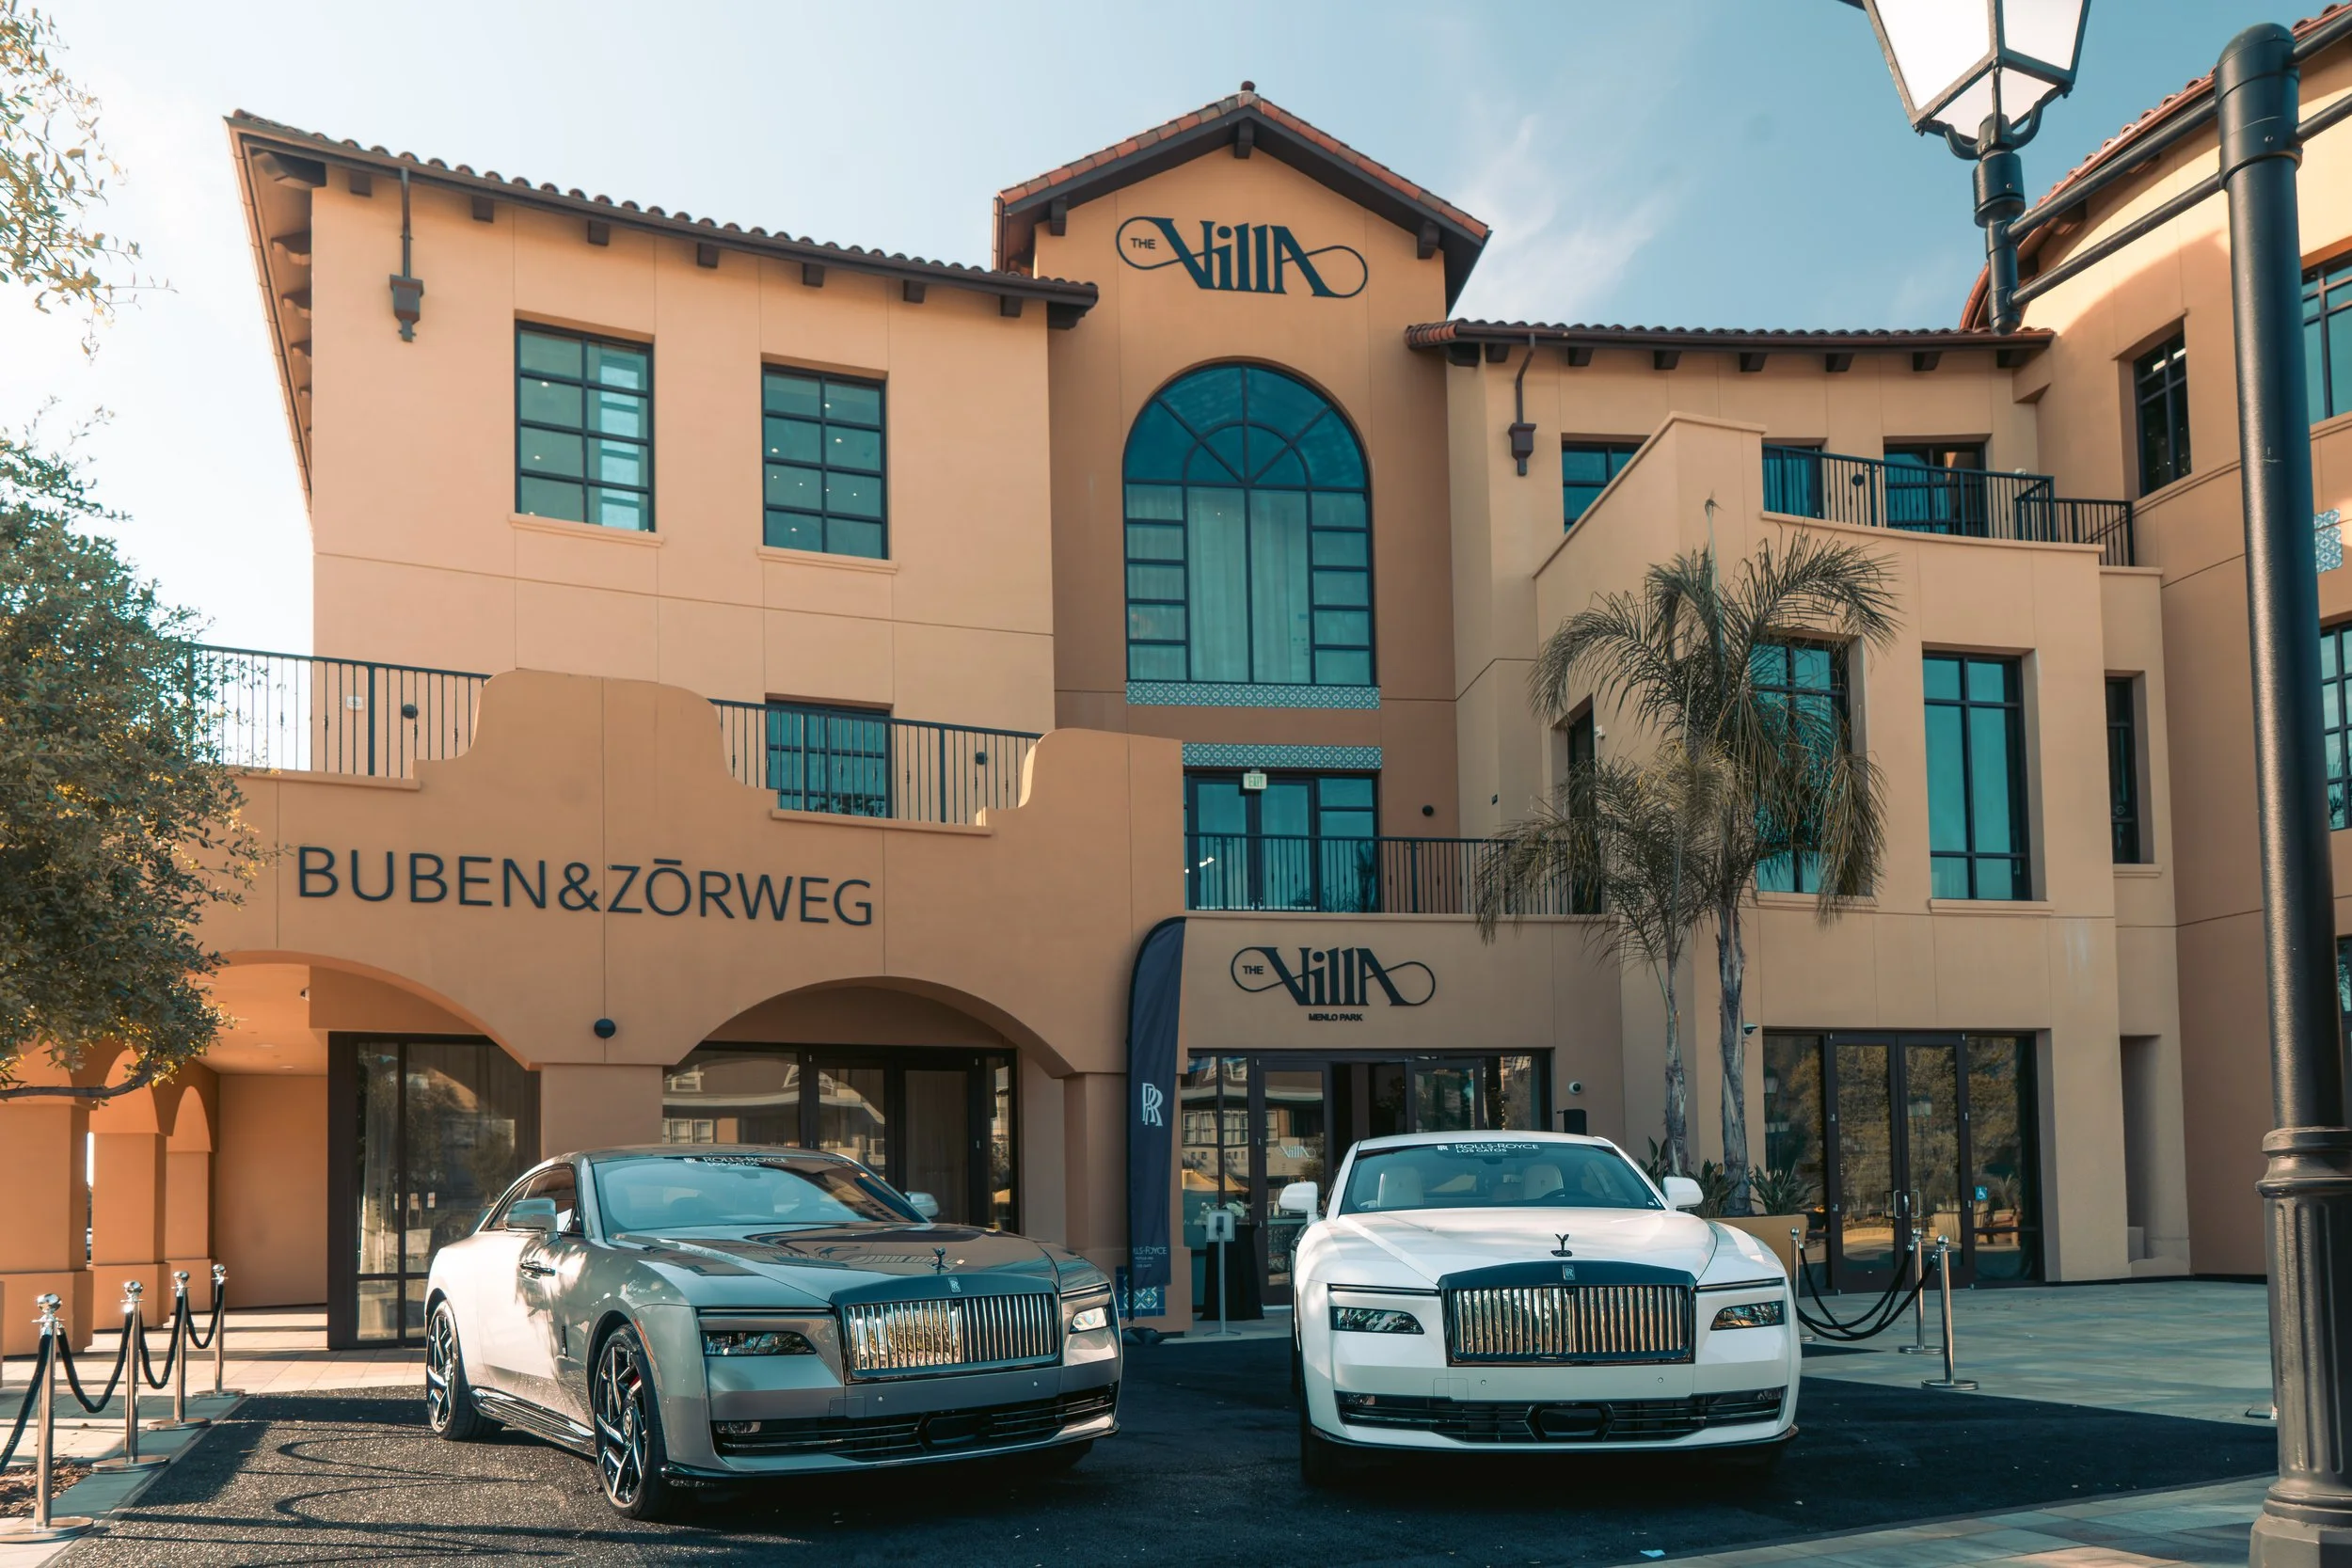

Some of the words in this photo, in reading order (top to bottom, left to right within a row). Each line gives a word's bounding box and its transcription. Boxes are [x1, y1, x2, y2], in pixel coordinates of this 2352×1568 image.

[1131, 237, 1156, 250] THE
[1243, 965, 1263, 974] THE
[1308, 1013, 1338, 1022] MENLO
[1339, 1013, 1363, 1022] PARK
